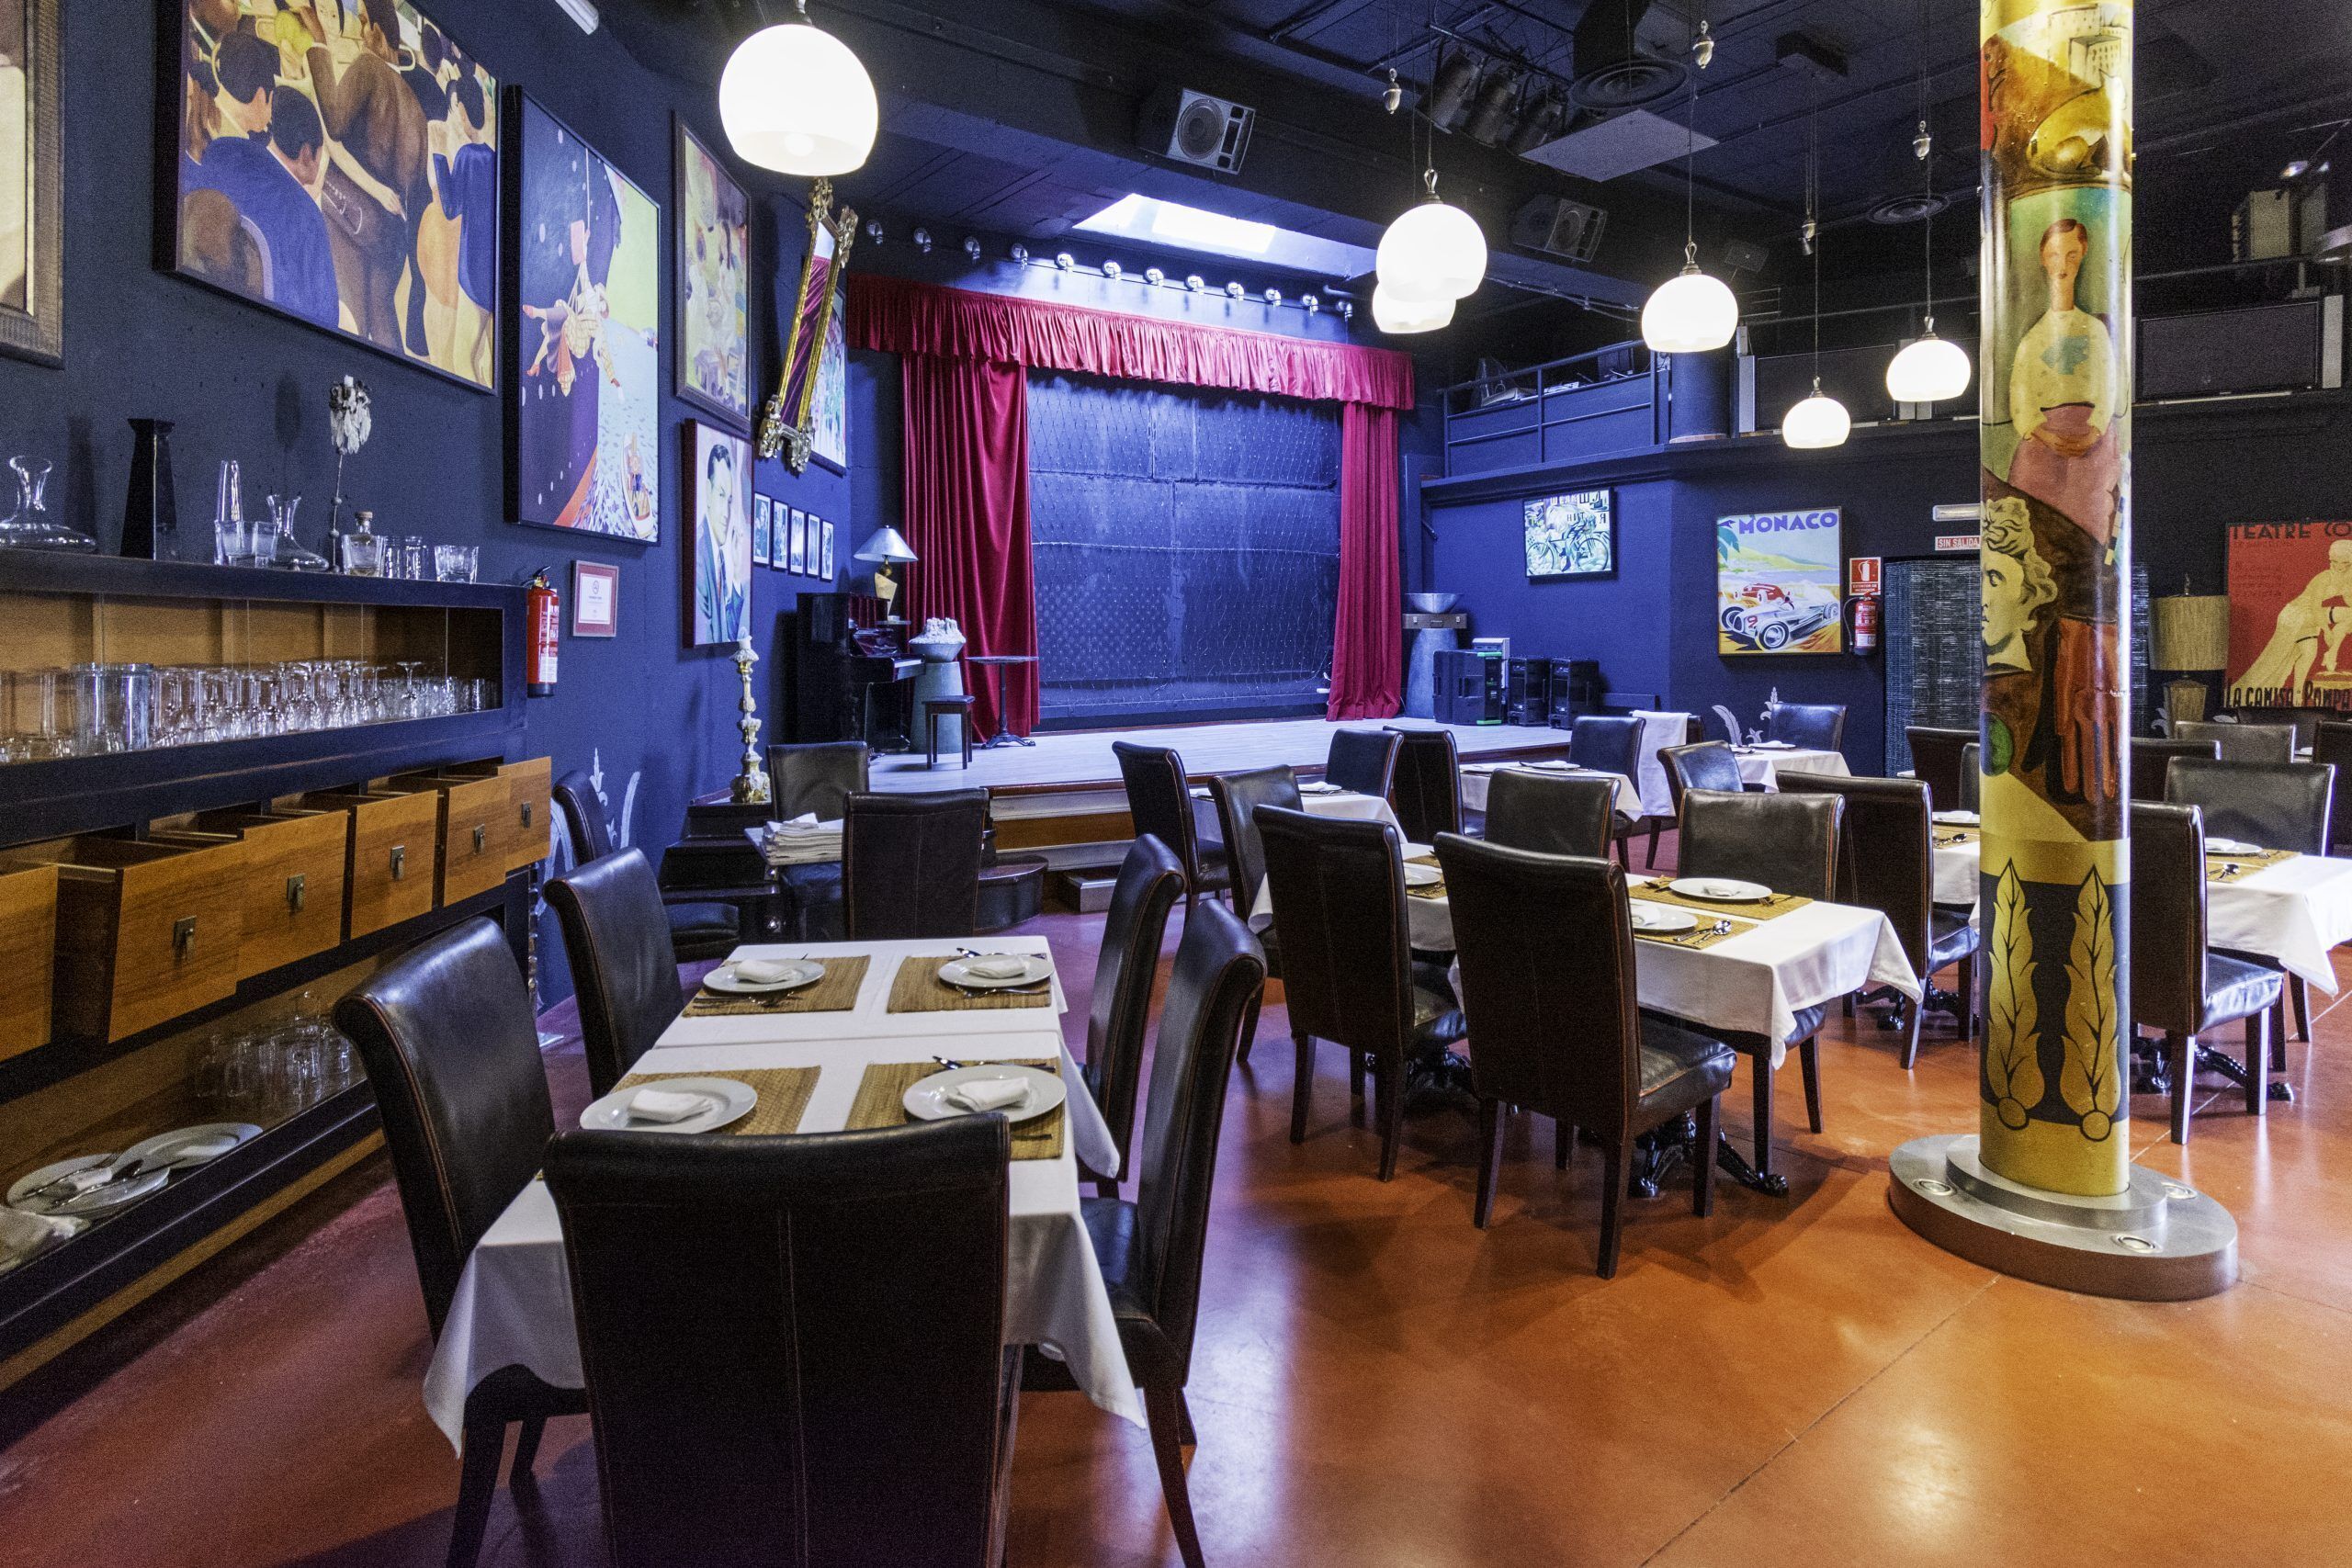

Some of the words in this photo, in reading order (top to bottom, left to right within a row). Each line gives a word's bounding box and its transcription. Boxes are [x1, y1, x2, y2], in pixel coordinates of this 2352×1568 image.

[1738, 512, 1838, 535] MONACO
[2228, 523, 2312, 539] TEATRE
[1939, 538, 1951, 547] SIN
[1952, 536, 1978, 547] SALIDA
[2225, 678, 2242, 707] LA
[2245, 687, 2294, 706] CAMISA
